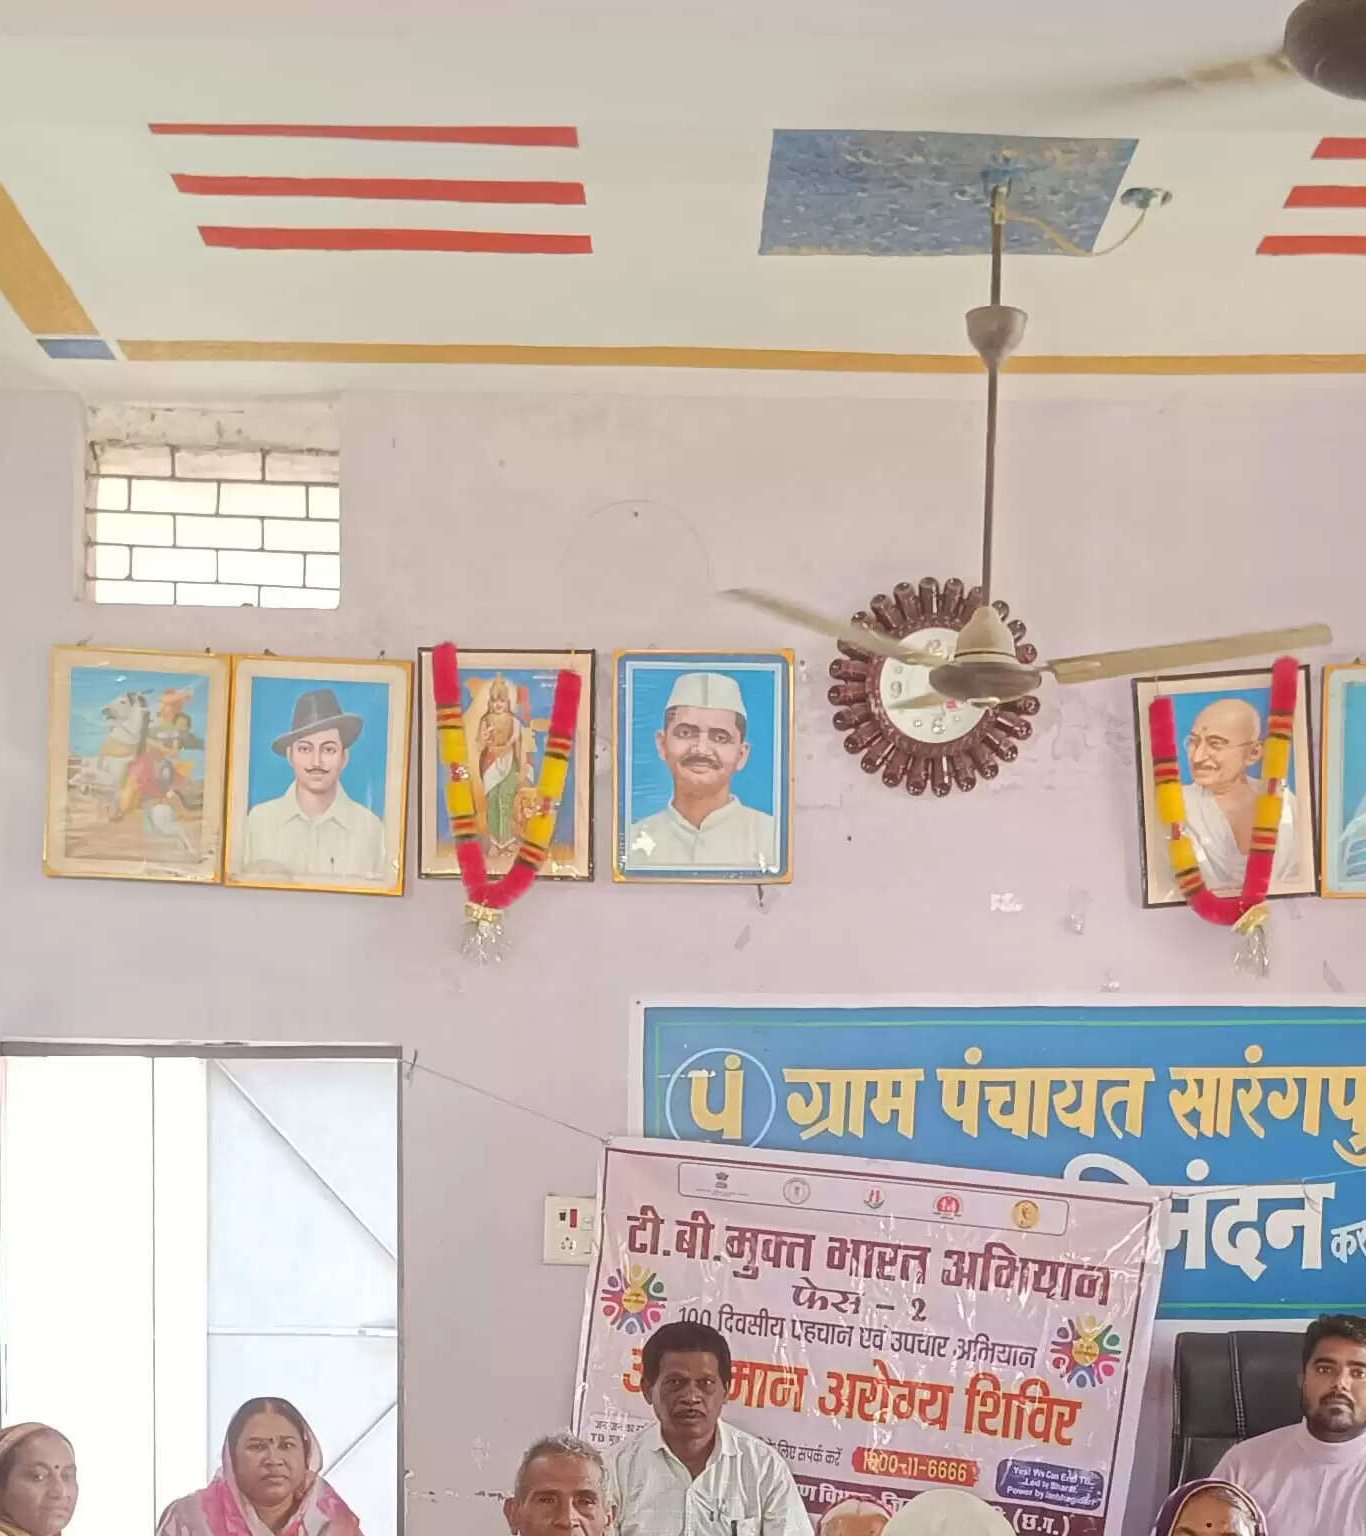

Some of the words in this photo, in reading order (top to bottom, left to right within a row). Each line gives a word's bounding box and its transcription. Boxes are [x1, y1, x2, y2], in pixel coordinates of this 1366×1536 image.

[782, 1067, 925, 1141] ग्राम
[935, 1046, 1156, 1141] पंचायत
[825, 1235, 932, 1286] भारत
[941, 1241, 1112, 1306] अभियान
[717, 1303, 786, 1339] दिवसीय
[791, 1317, 853, 1349] पहचान
[858, 1319, 884, 1351] एवं
[890, 1330, 951, 1359] उपचार
[952, 1331, 1038, 1370] अभियान
[964, 1371, 1083, 1447] शिविर
